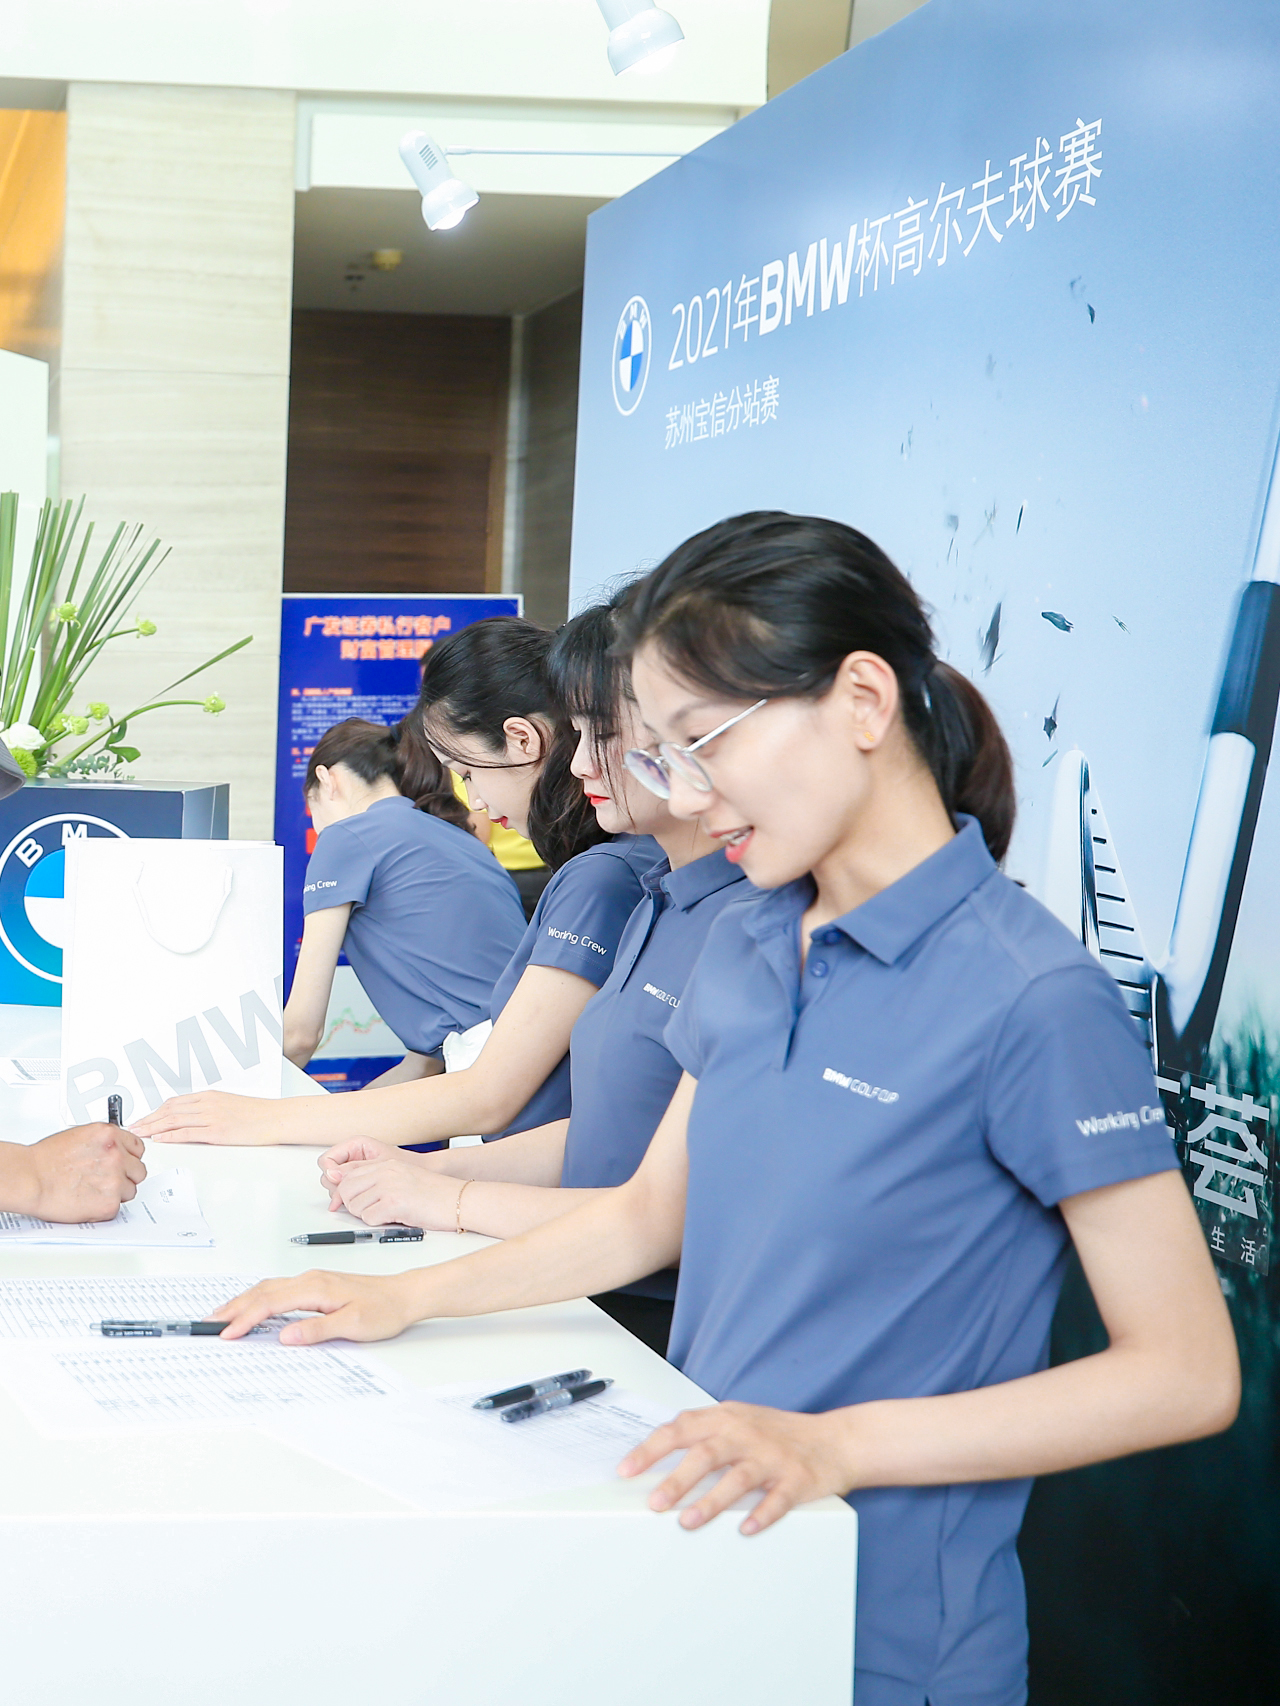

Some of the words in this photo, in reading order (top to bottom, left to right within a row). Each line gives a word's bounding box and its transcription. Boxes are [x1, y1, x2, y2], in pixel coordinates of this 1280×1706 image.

[668, 116, 1104, 371] 2021年BMW杯高尔夫球赛
[664, 374, 780, 450] 苏州宝信分站赛
[316, 880, 338, 889] Crew
[580, 935, 608, 956] Crew
[849, 1078, 880, 1099] GOLF
[1075, 1110, 1141, 1138] Working
